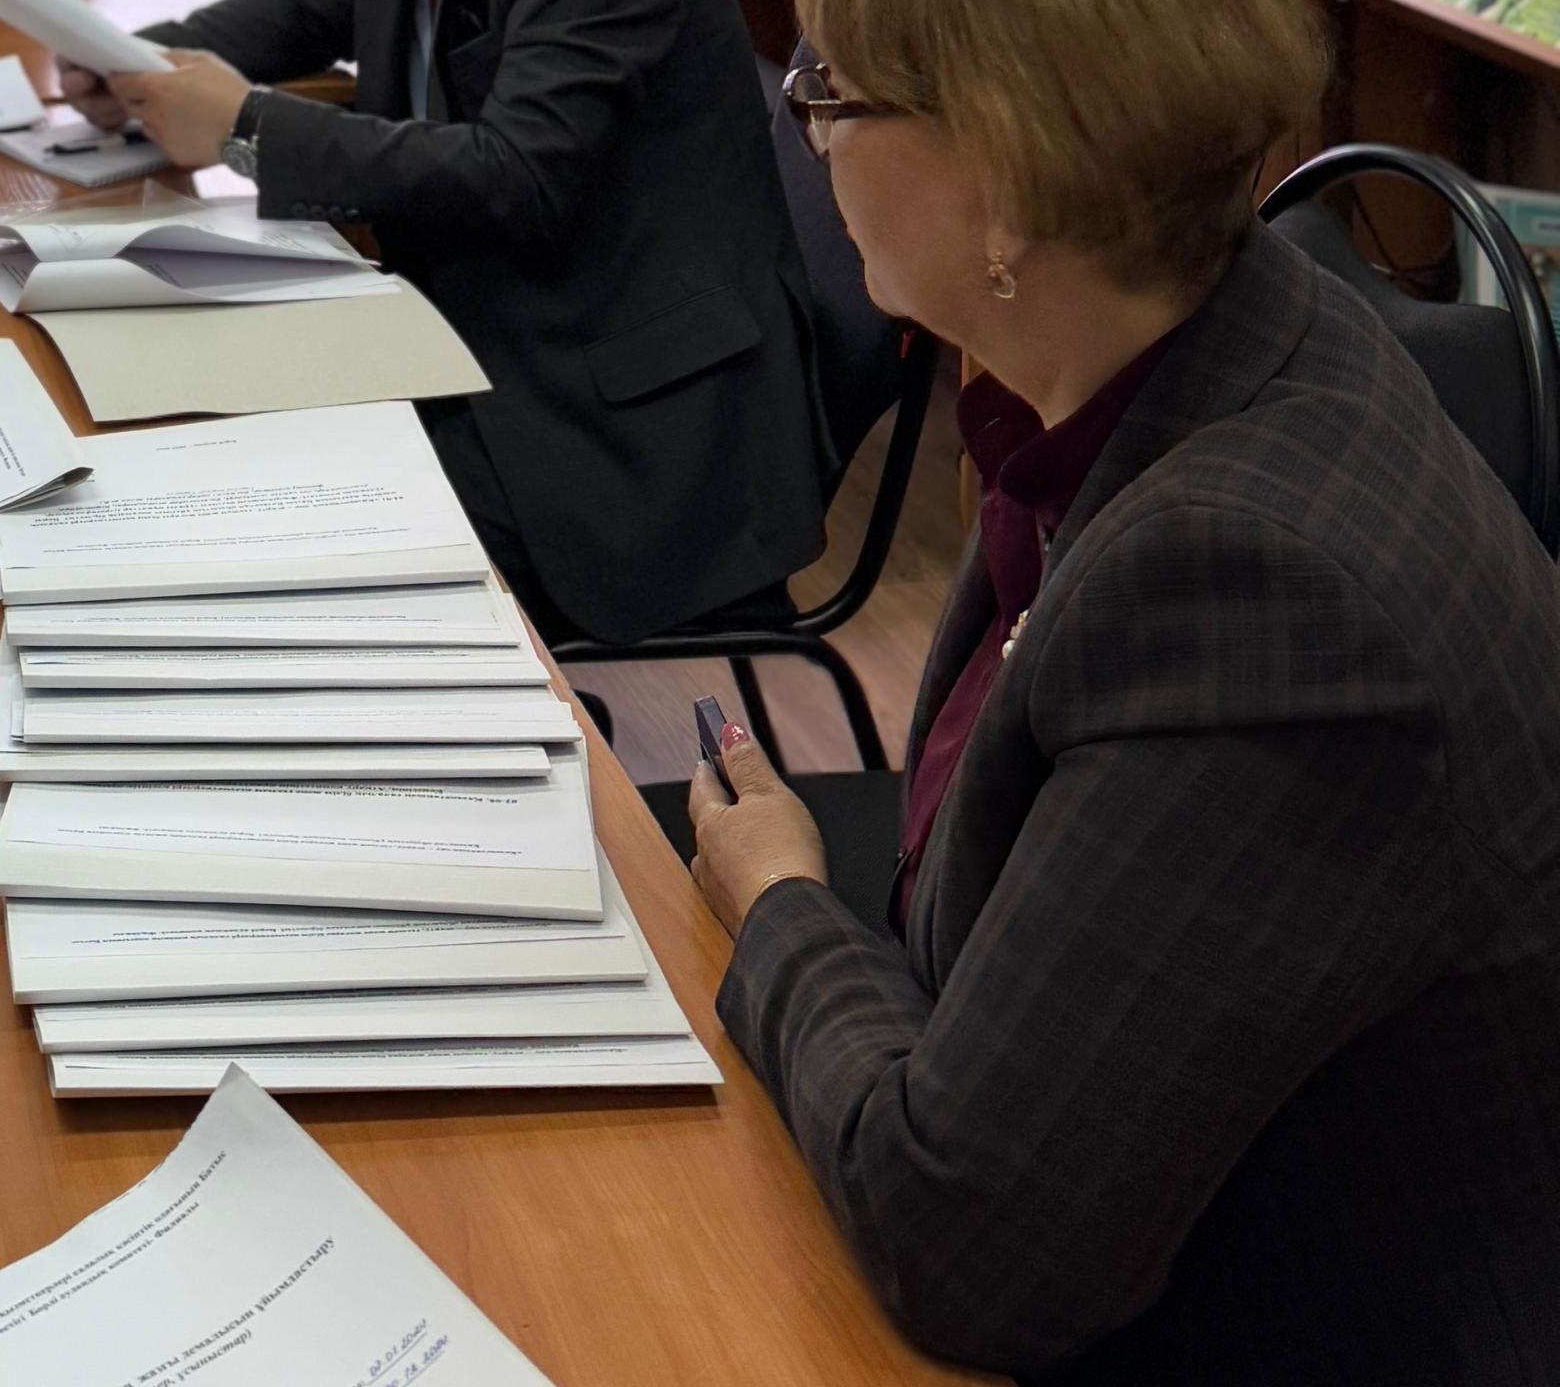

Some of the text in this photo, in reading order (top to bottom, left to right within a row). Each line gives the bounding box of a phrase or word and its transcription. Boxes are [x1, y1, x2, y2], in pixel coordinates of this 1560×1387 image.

[198, 1150, 227, 1182] Батыс
[183, 1310, 255, 1360] демалысын
[255, 1237, 334, 1312] ұйымдастыру
